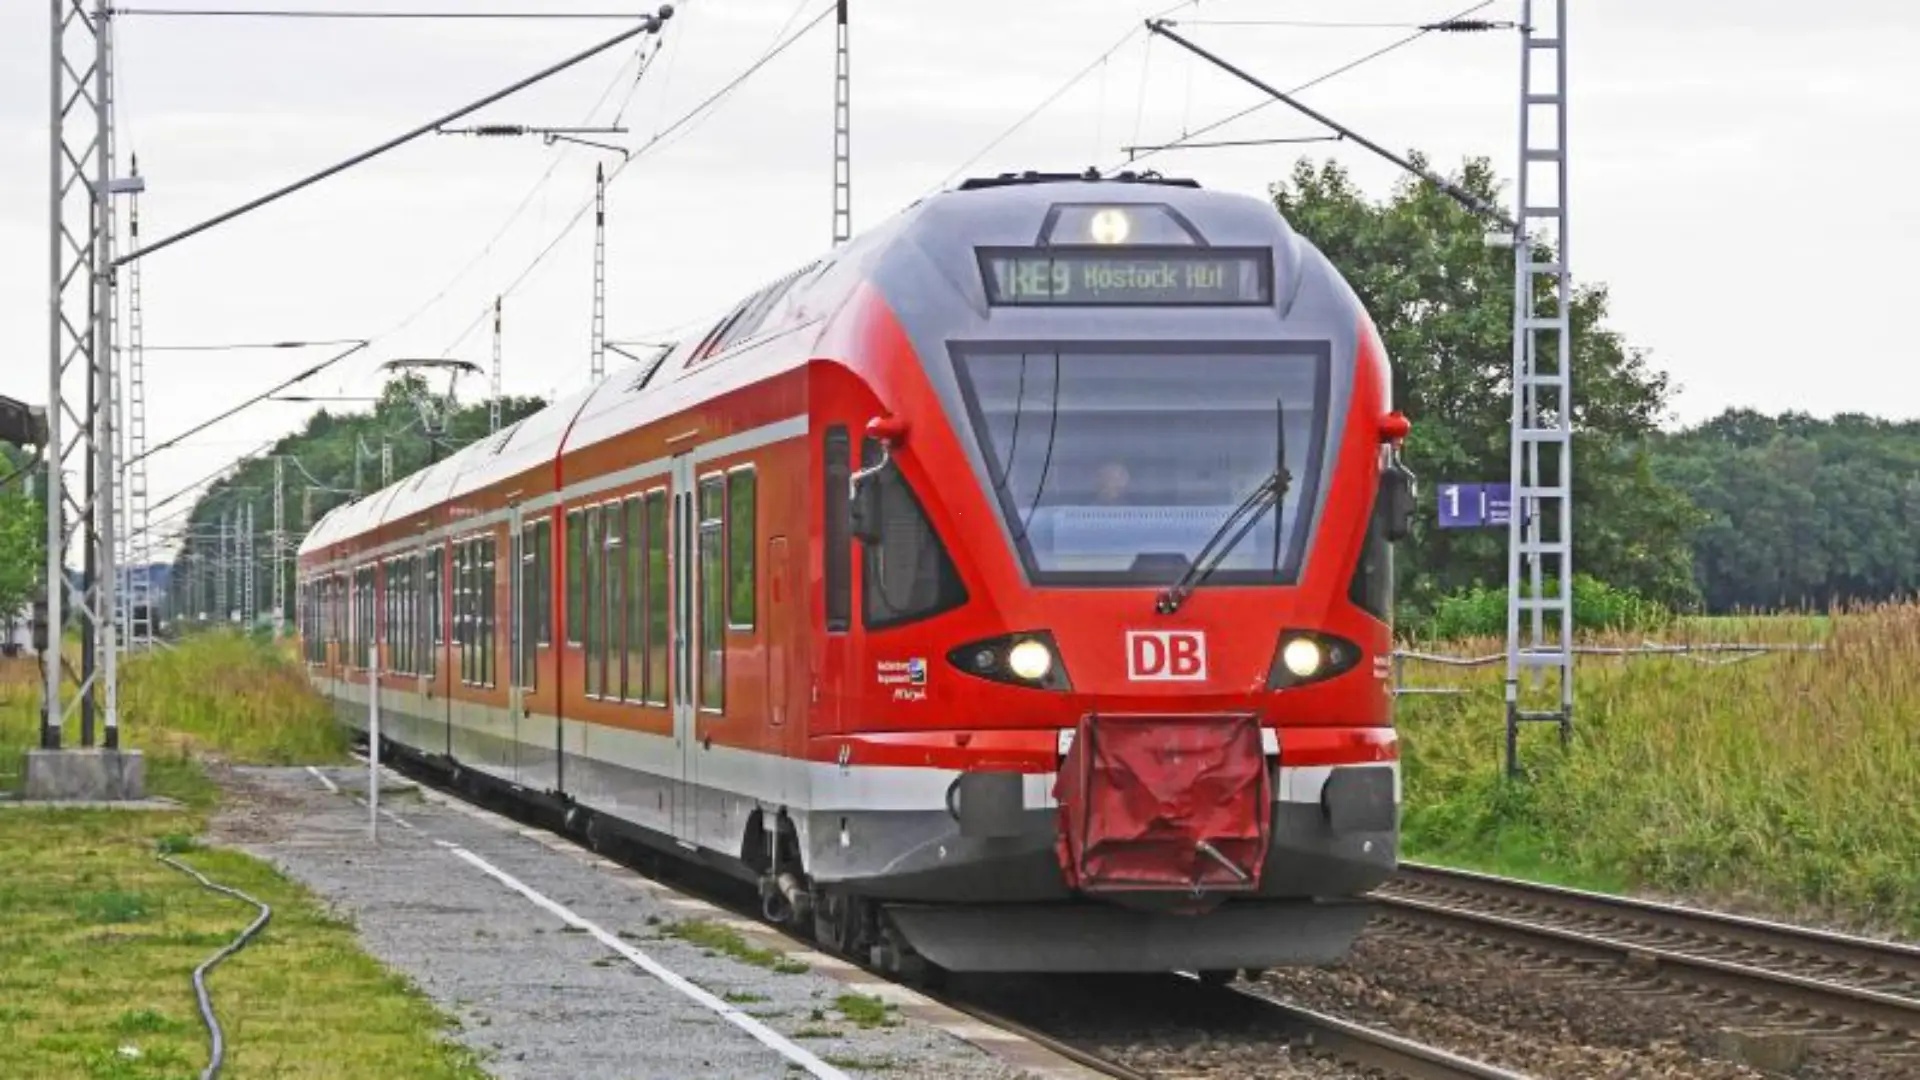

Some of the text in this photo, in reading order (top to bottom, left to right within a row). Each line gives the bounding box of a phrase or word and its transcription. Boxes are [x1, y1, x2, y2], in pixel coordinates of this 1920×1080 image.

[1009, 259, 1070, 295] RE9
[1444, 484, 1459, 517] 1
[1133, 635, 1201, 675] DB
